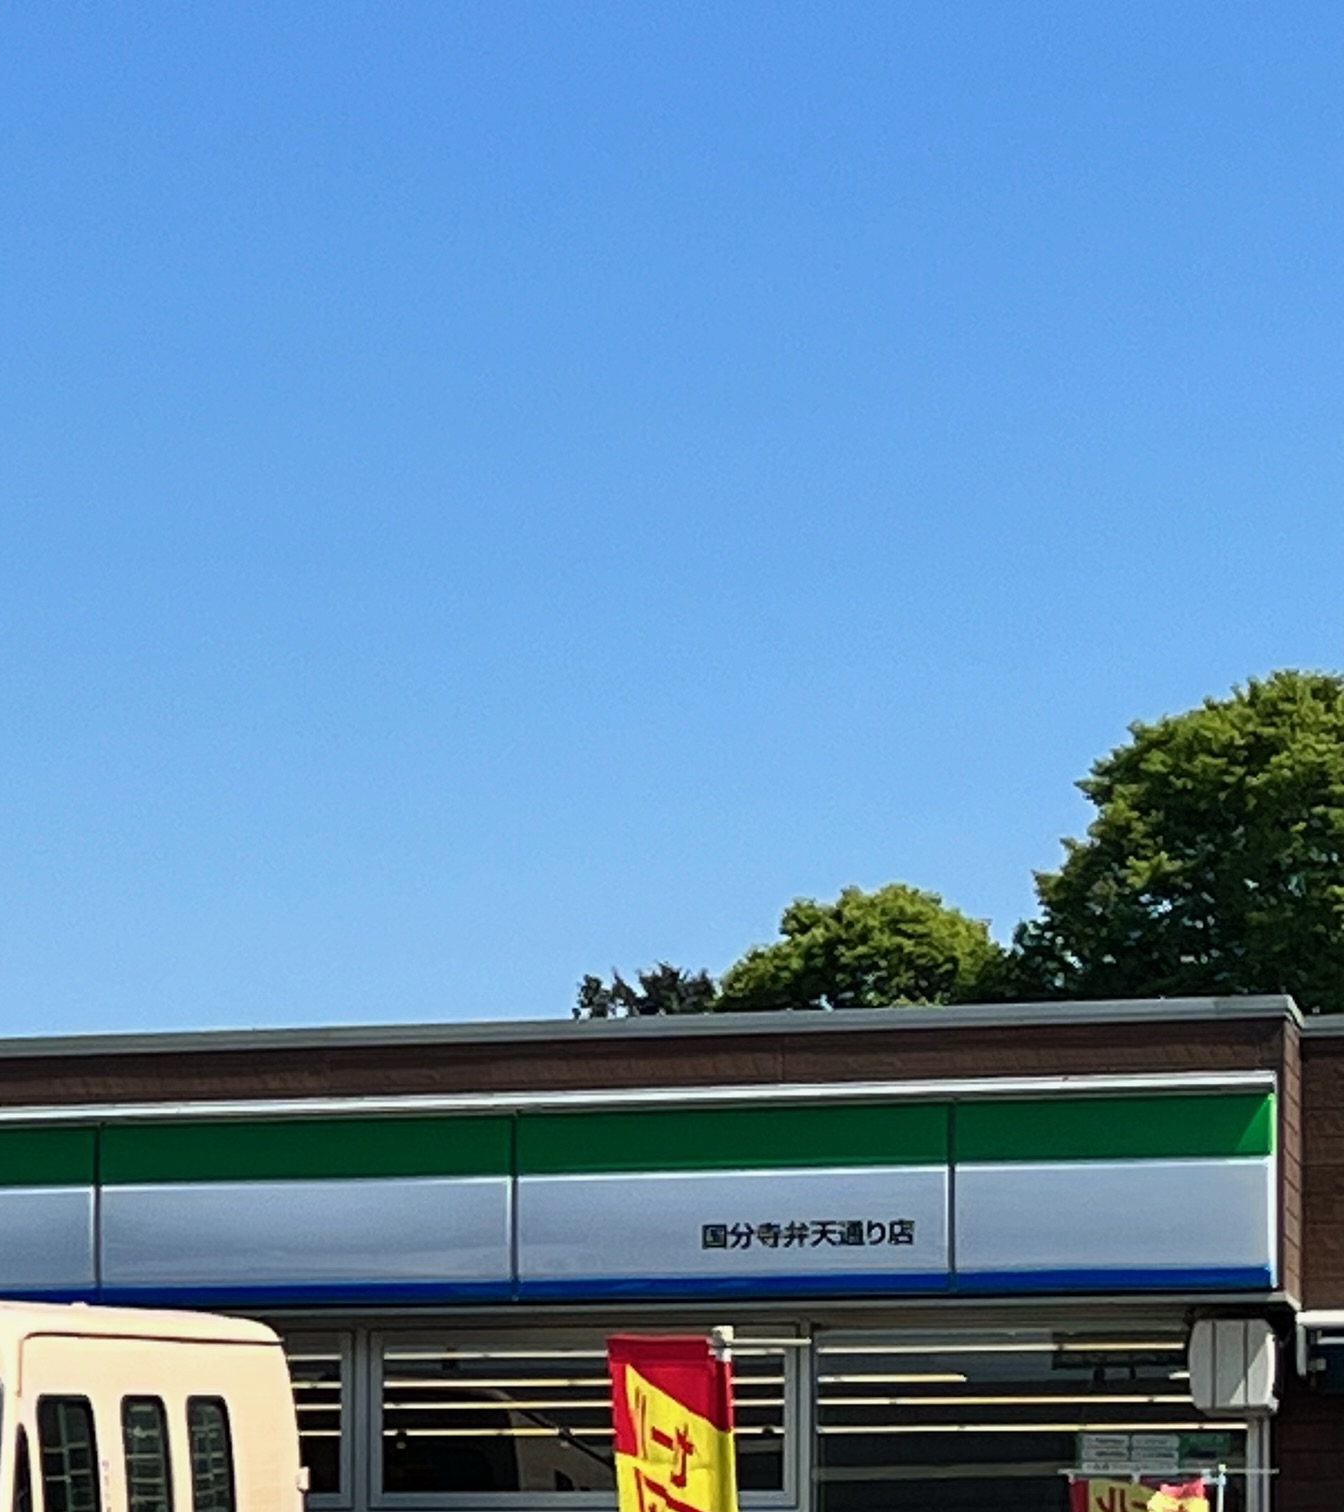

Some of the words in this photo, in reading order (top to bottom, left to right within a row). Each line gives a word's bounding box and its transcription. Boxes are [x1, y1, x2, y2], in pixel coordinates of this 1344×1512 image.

[702, 1220, 915, 1250] 国分寺弁天通り店
